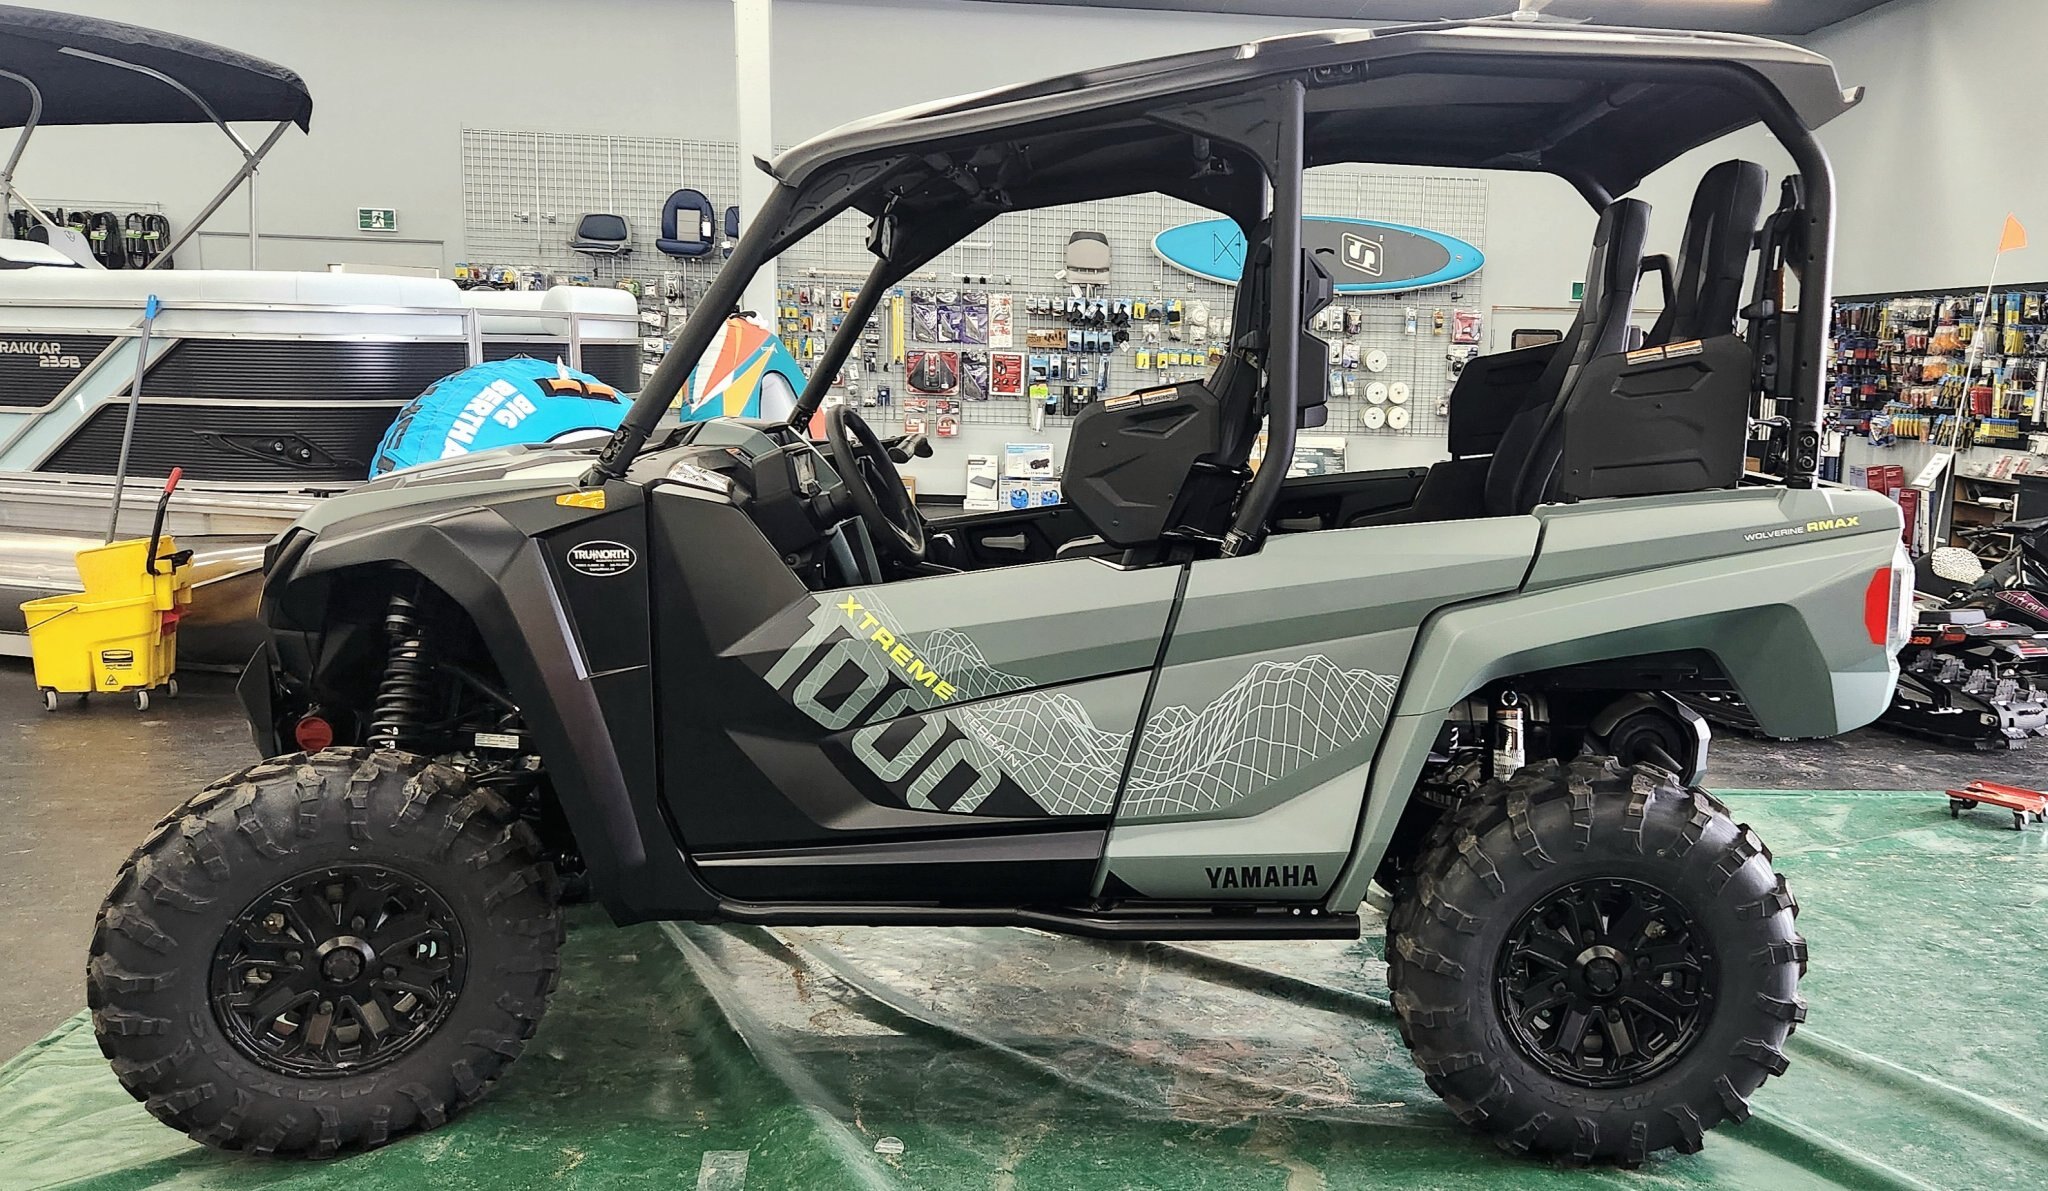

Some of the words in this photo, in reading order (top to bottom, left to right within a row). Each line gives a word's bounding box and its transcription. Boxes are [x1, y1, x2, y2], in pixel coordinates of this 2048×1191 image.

[440, 379, 518, 460] BERTHA
[492, 393, 538, 430] BIG
[1744, 526, 1804, 541] WOLVERINE
[1806, 516, 1859, 532] RMAX
[836, 593, 957, 702] XTREME
[763, 594, 1002, 814] 1000
[962, 706, 1021, 768] TERRAIN
[1205, 865, 1318, 888] YAMAHA
